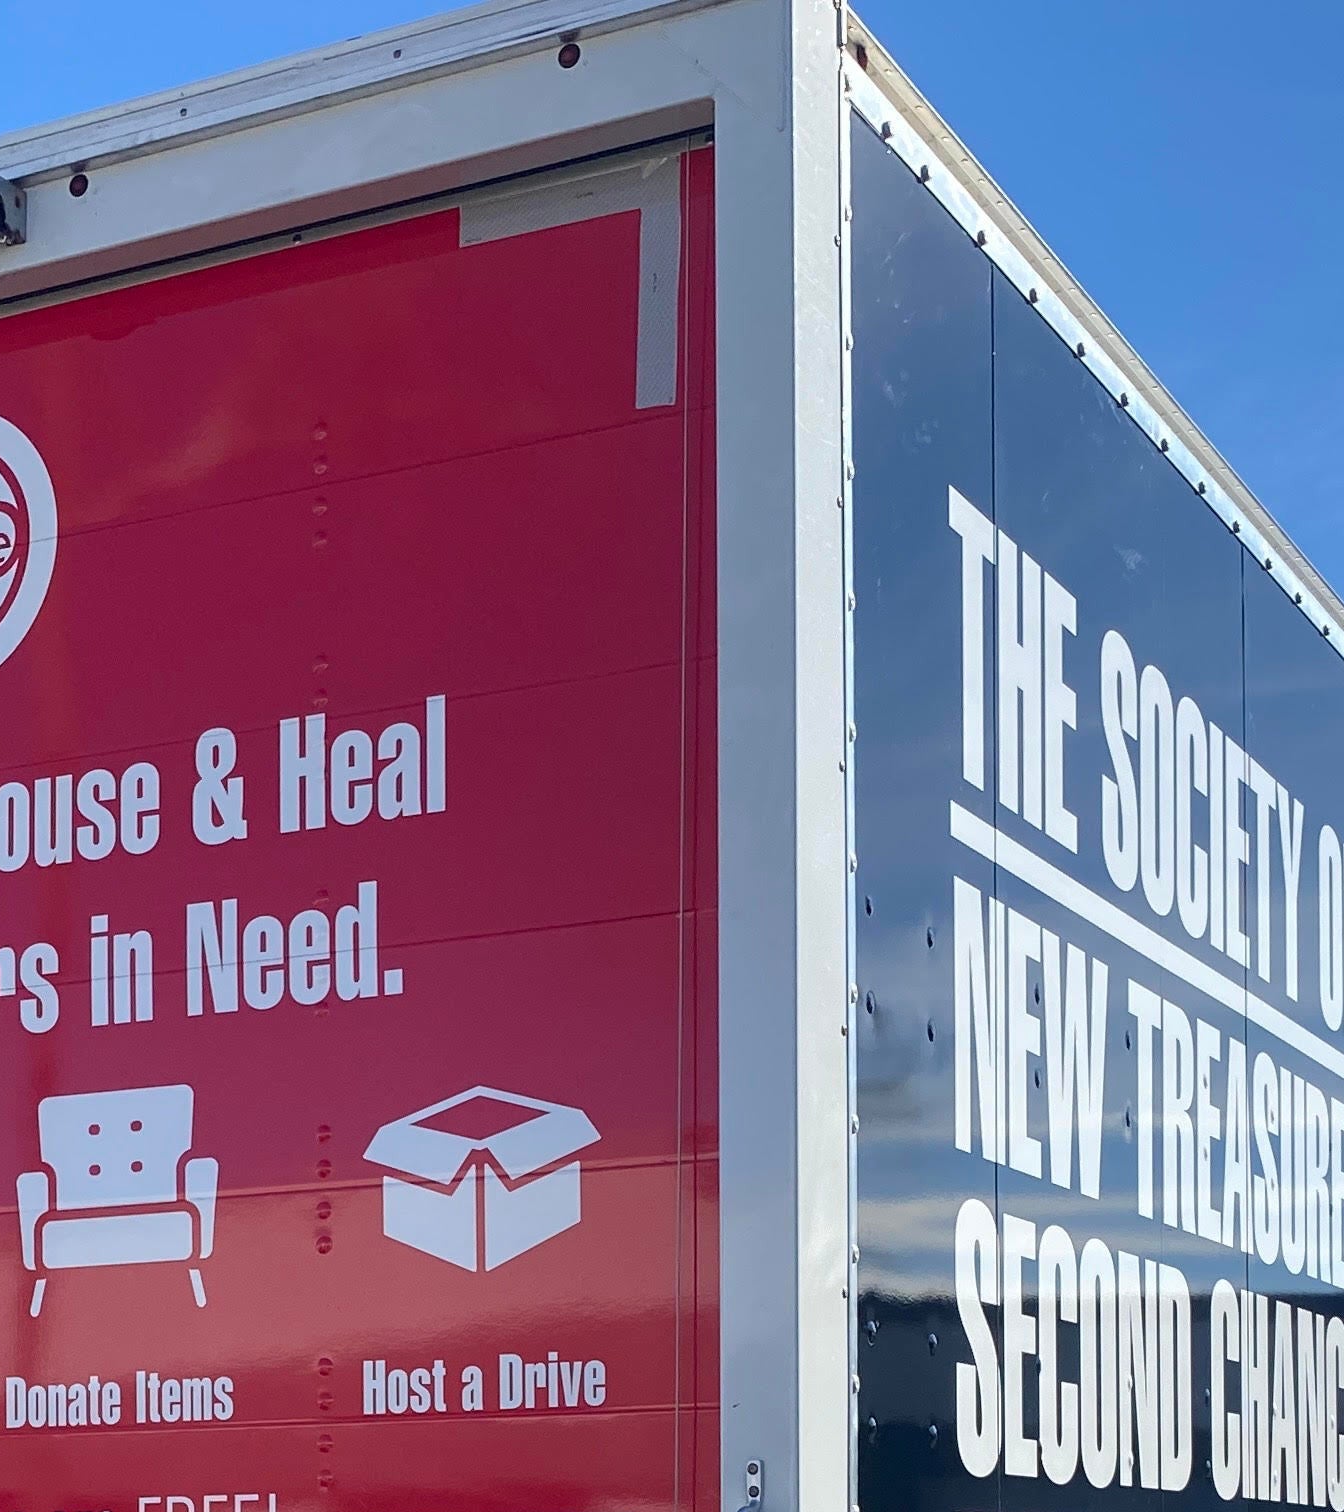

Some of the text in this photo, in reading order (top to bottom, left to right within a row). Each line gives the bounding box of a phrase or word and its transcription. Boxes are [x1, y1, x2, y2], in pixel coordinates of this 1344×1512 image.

[193, 728, 247, 845] &
[280, 695, 445, 833] Heal
[948, 484, 1078, 855] THE
[1100, 629, 1305, 1002] SOCIETY
[91, 915, 153, 1026] in
[187, 881, 403, 1016] Need.
[953, 875, 1109, 1200] NEW
[6, 1371, 233, 1428] Donate Items
[363, 1352, 605, 1414] Host a Drive
[954, 1199, 1193, 1492] SECOND
